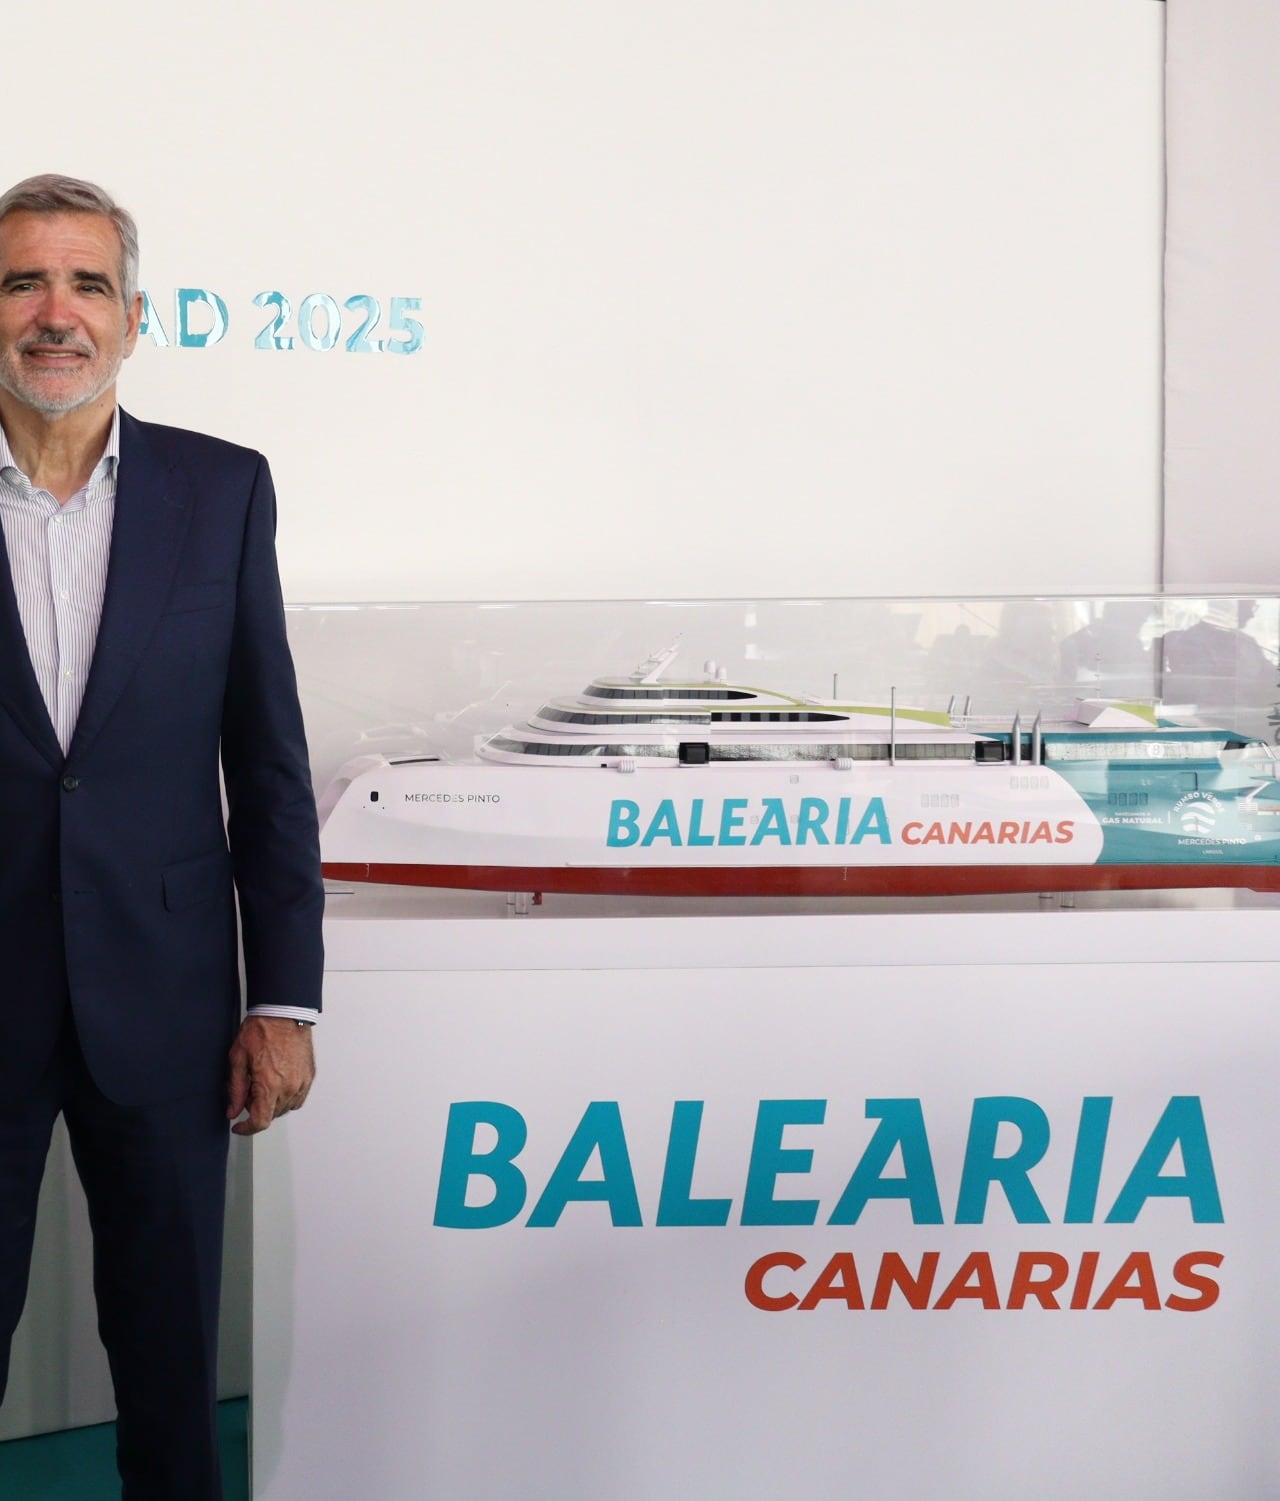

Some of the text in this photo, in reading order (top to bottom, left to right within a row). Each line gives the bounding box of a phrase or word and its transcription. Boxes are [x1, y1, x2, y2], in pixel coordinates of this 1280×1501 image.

[252, 290, 425, 355] 2025
[404, 793, 501, 803] MERCEDES PINTO
[1173, 792, 1200, 812] RUMBO
[901, 820, 1074, 846] CANARIAS
[1178, 838, 1221, 846] MERCEDES
[743, 1250, 1226, 1313] CANARIAS
